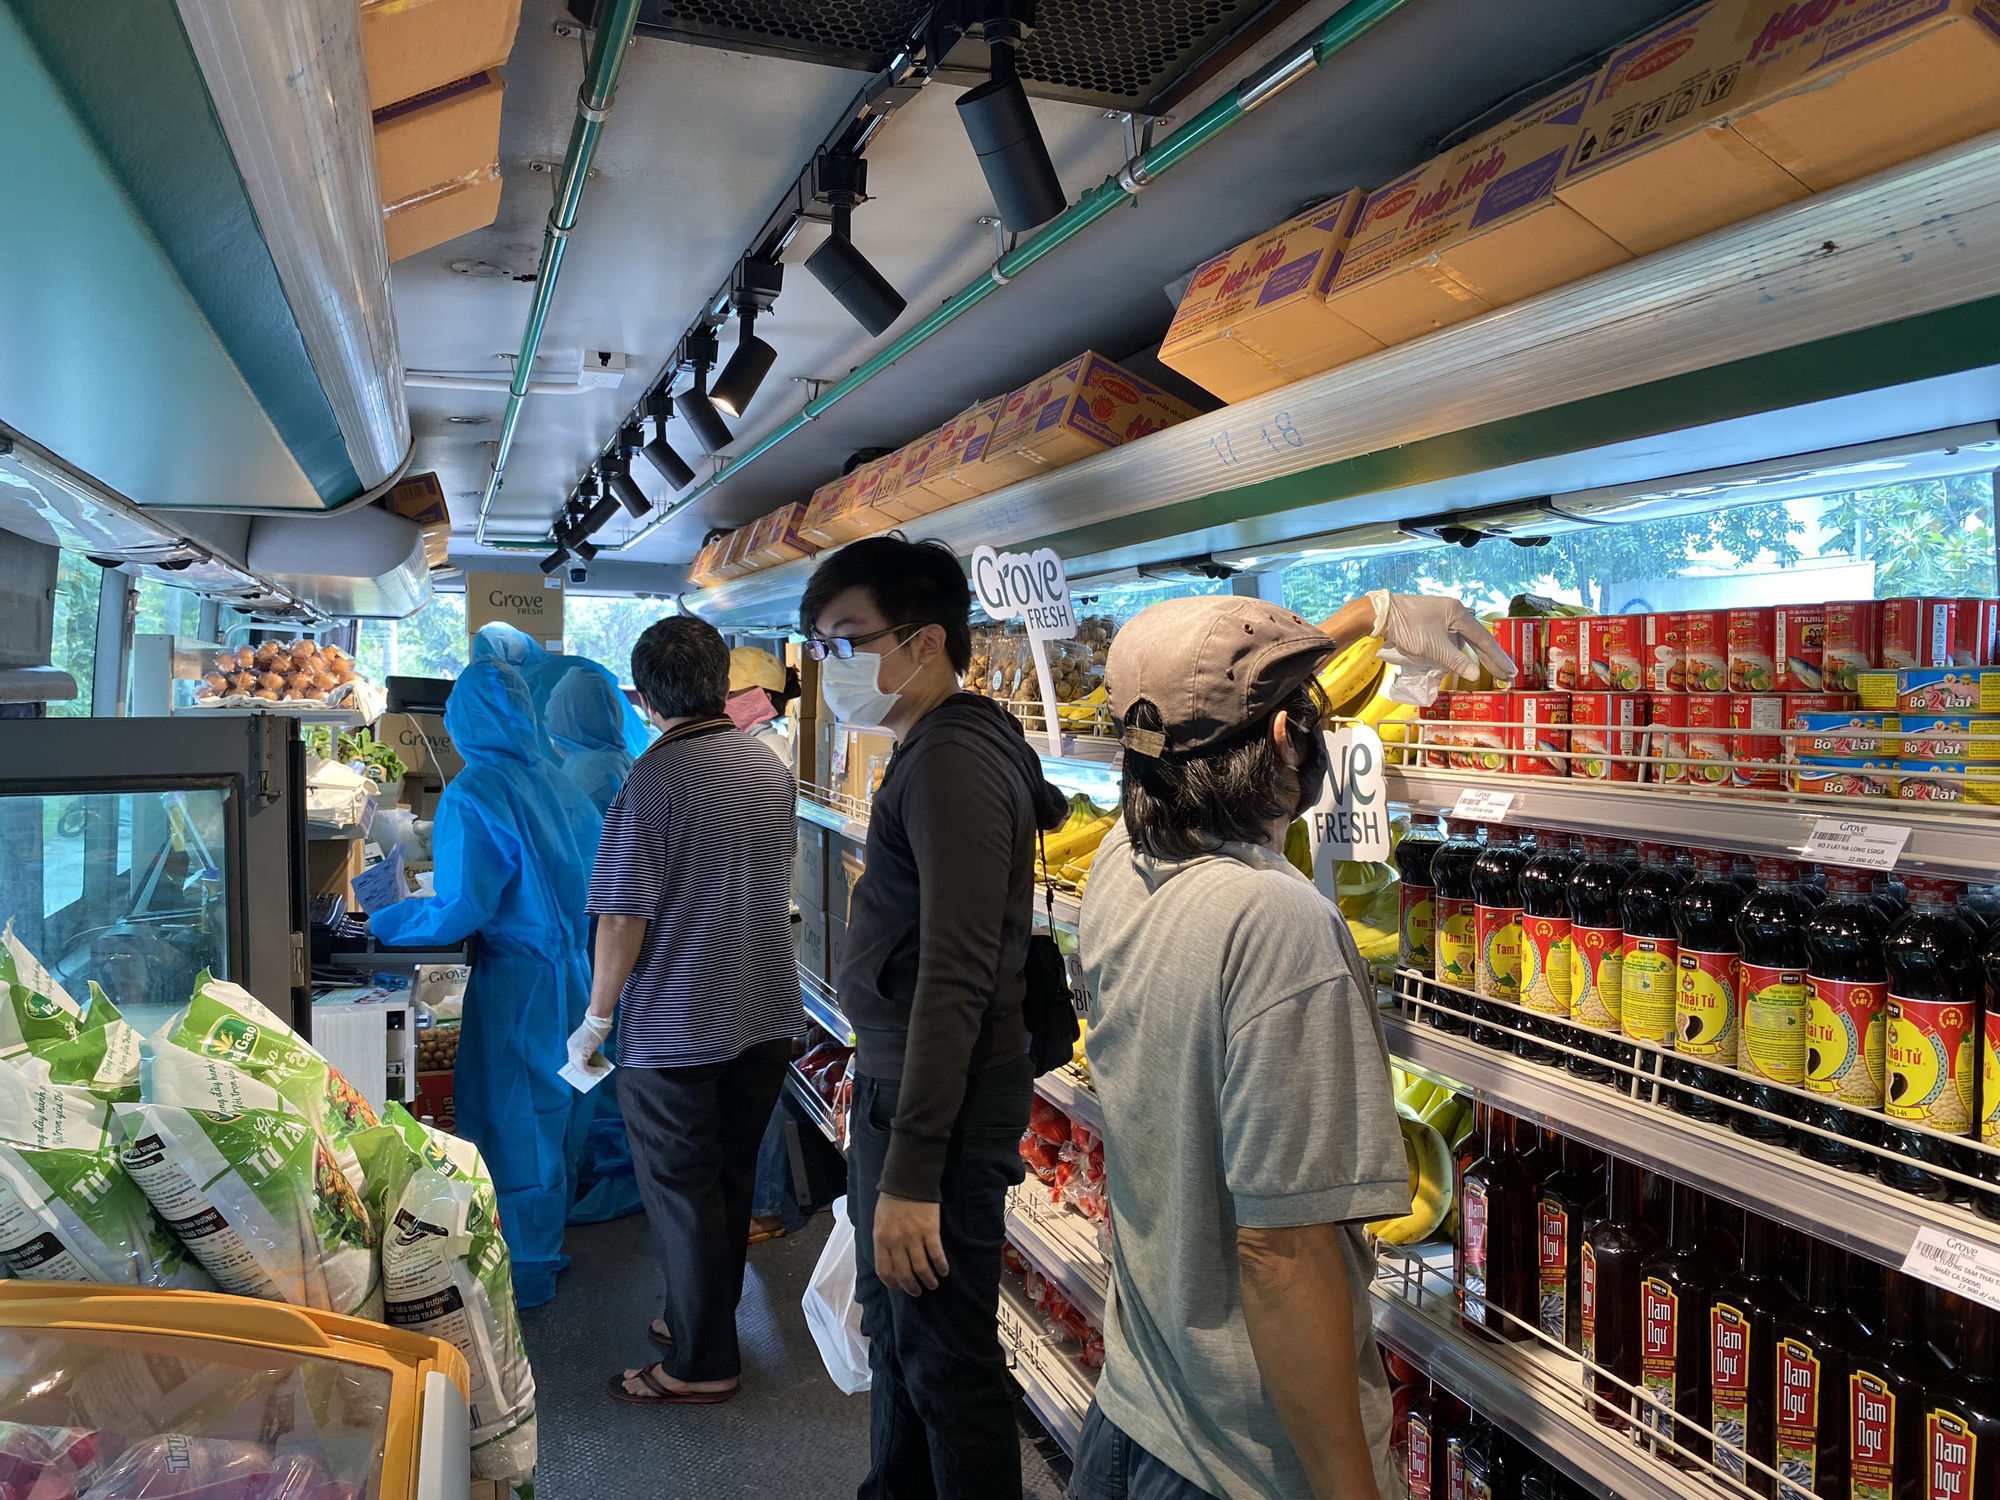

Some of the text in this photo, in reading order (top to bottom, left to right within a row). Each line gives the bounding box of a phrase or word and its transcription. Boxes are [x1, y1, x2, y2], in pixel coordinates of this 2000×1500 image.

[1260, 410, 1305, 454] 18
[977, 556, 1063, 609] Grove
[489, 590, 544, 609] Grove
[517, 607, 544, 616] FRESH
[1026, 604, 1070, 630] FRESH
[1910, 695, 1926, 709] Bò
[1928, 690, 1942, 711] 2
[399, 730, 451, 749] Grove
[1814, 737, 1832, 750] Bò
[1834, 738, 1848, 753] 2
[1904, 740, 1918, 753] Bò
[1919, 740, 1932, 756] 2
[1901, 785, 1914, 798] Bò
[1916, 783, 1928, 801] 2
[1315, 811, 1380, 845] FRESH
[1839, 822, 1868, 833] Grove
[1445, 932, 1462, 944] Tam
[1496, 943, 1515, 956] Tam
[429, 967, 468, 985] Grove
[1681, 990, 1716, 1009] Thái Tử
[235, 1025, 257, 1051] Gạo
[1820, 1025, 1834, 1042] Tử
[1906, 1047, 1922, 1066] Tử
[246, 1141, 285, 1179] Từ
[71, 1166, 113, 1206] Từ
[195, 1211, 218, 1228] DƯỠNG
[1543, 1214, 1563, 1236] Nam
[1543, 1234, 1560, 1263] Ngư
[1946, 1237, 1979, 1257] Grove
[1951, 1272, 1960, 1281] CA
[1961, 1276, 1982, 1290] 500ML
[1964, 1267, 1979, 1277] TAM
[425, 1290, 451, 1310] DƯỠNG
[1648, 1295, 1671, 1321] Nam
[421, 1307, 444, 1320] TRẮNG
[1648, 1319, 1669, 1352] Ngư
[1717, 1323, 1742, 1350] Nam
[1717, 1348, 1739, 1382] Ngư
[1784, 1358, 1811, 1389] Nam
[1783, 1385, 1807, 1421] Ngư
[1858, 1391, 1886, 1423] Nam
[1940, 1418, 1962, 1432] CHIN-SU
[1858, 1419, 1883, 1457] Ngư
[1935, 1432, 1967, 1466] Nam
[1934, 1461, 1962, 1500] Ngư
